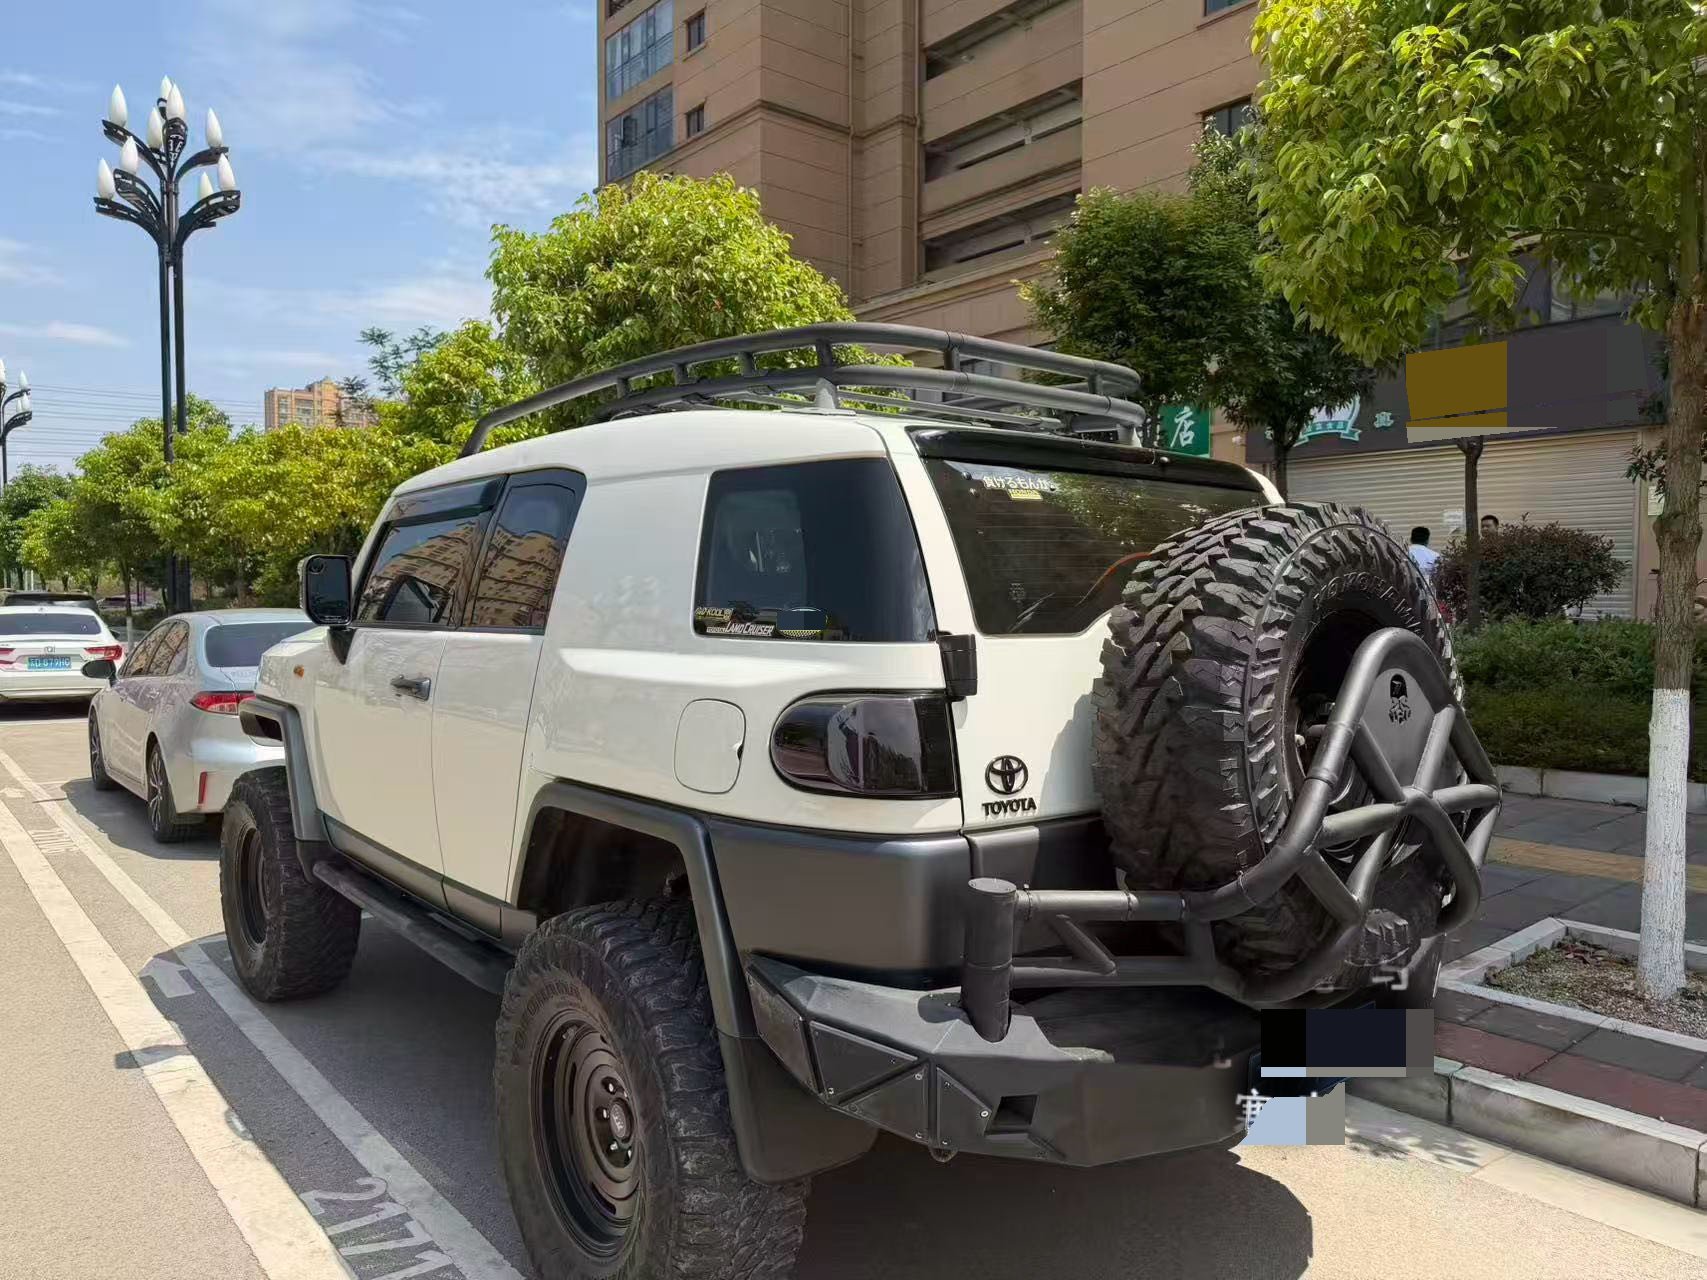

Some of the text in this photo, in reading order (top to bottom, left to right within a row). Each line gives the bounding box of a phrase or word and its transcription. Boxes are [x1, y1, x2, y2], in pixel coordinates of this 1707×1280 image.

[1170, 405, 1195, 447] 店
[726, 621, 744, 634] LAND
[743, 623, 774, 636] CRUISER
[982, 797, 1037, 816] TOYOTA
